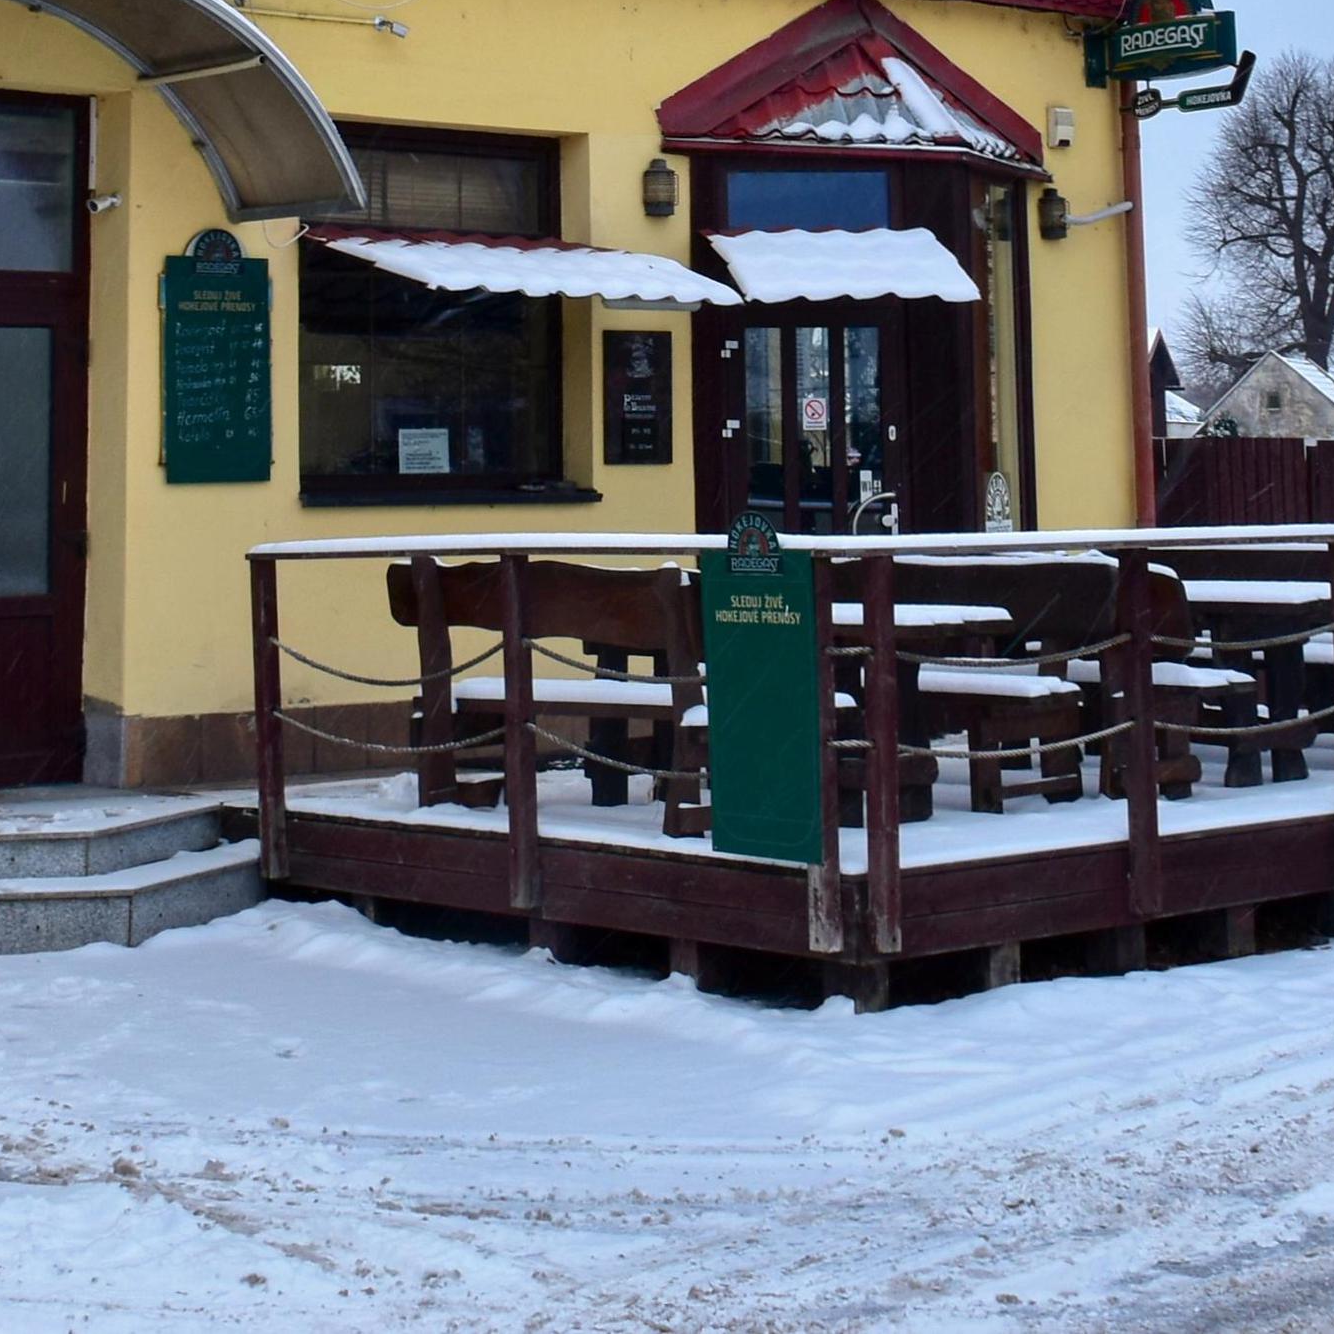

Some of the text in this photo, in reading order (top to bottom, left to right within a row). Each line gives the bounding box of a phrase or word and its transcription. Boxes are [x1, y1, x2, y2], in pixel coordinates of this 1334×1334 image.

[1120, 23, 1209, 57] RADEGAST
[730, 515, 777, 549] HOKEJOVKA
[731, 557, 780, 572] RADEGAST
[731, 595, 762, 608] SLEDUJ
